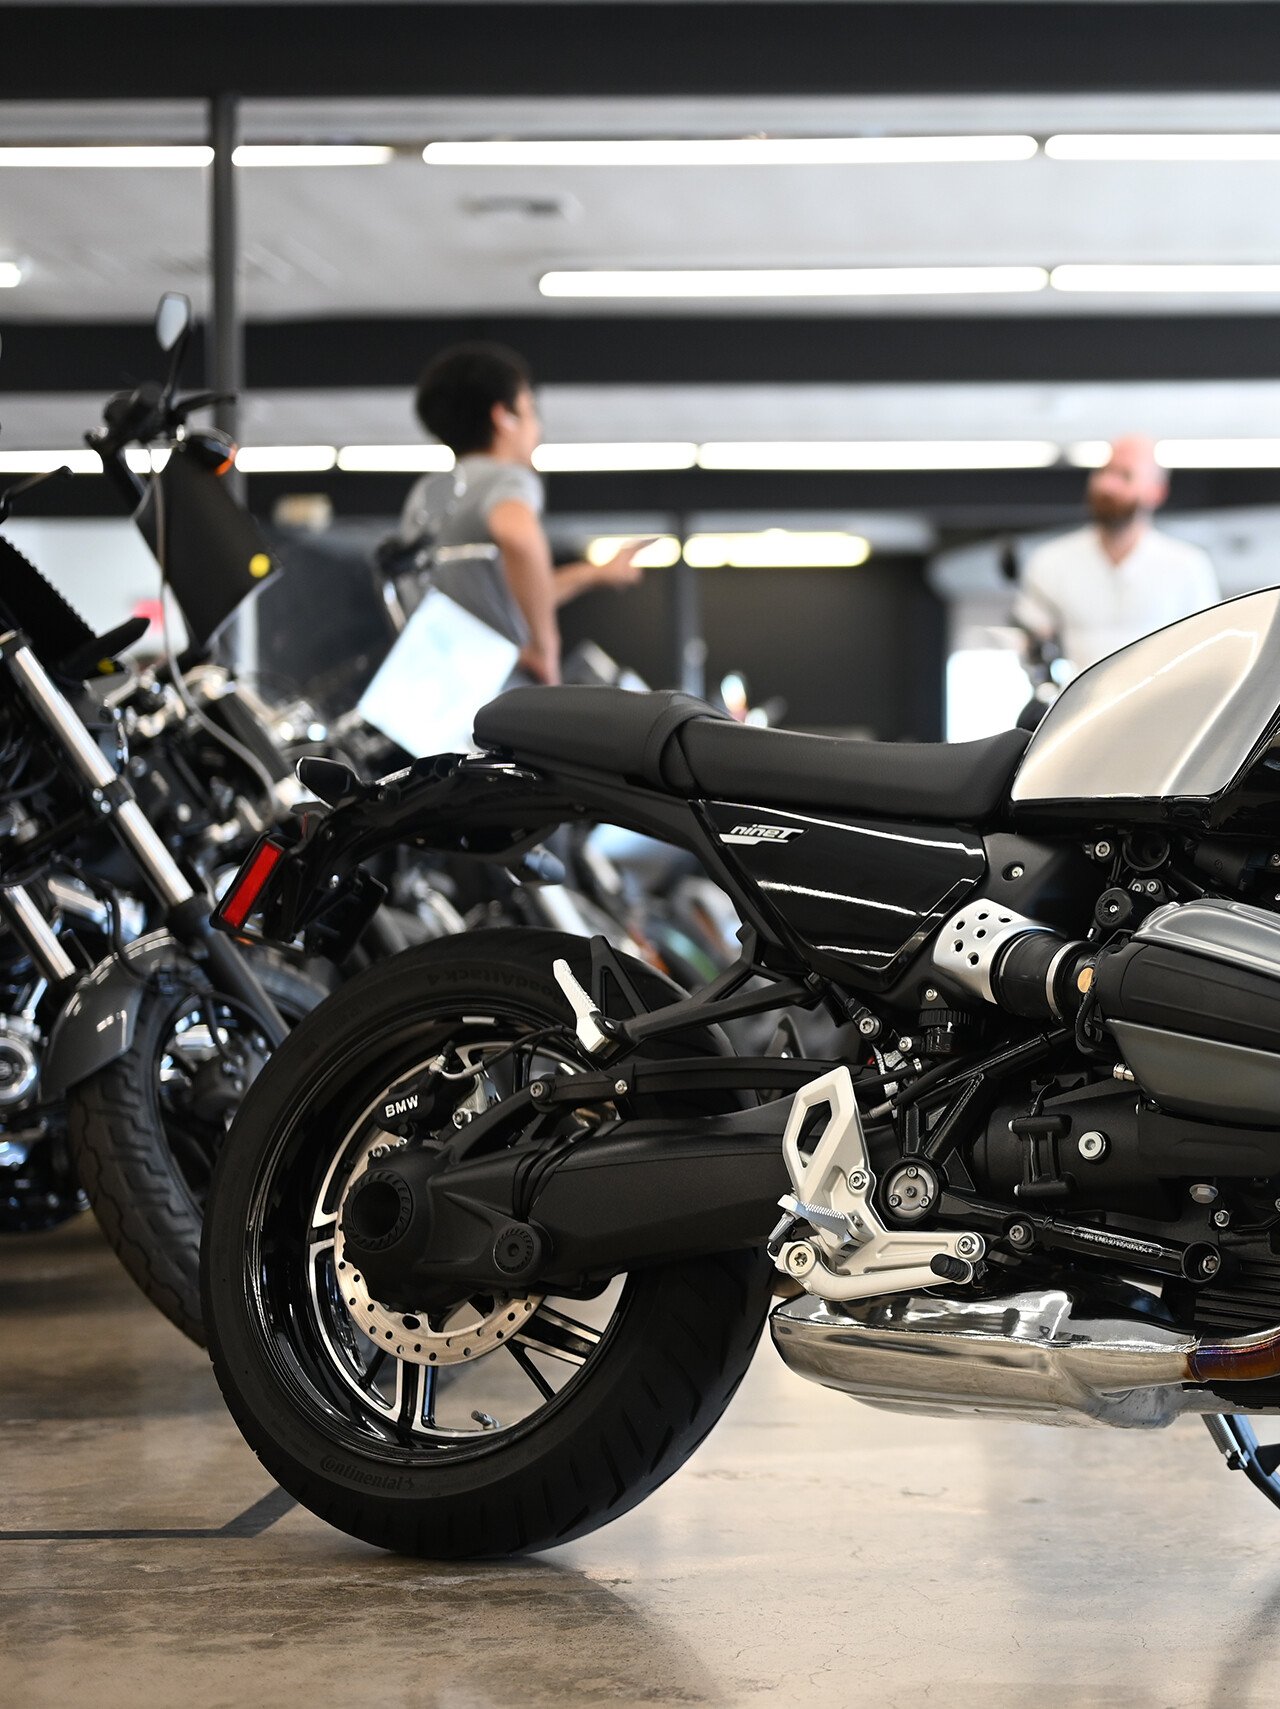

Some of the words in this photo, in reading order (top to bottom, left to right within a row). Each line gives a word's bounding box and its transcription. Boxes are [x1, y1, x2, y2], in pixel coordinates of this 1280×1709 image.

[724, 824, 804, 841] nineT
[385, 1095, 418, 1118] BMW
[319, 1454, 404, 1491] Continental
